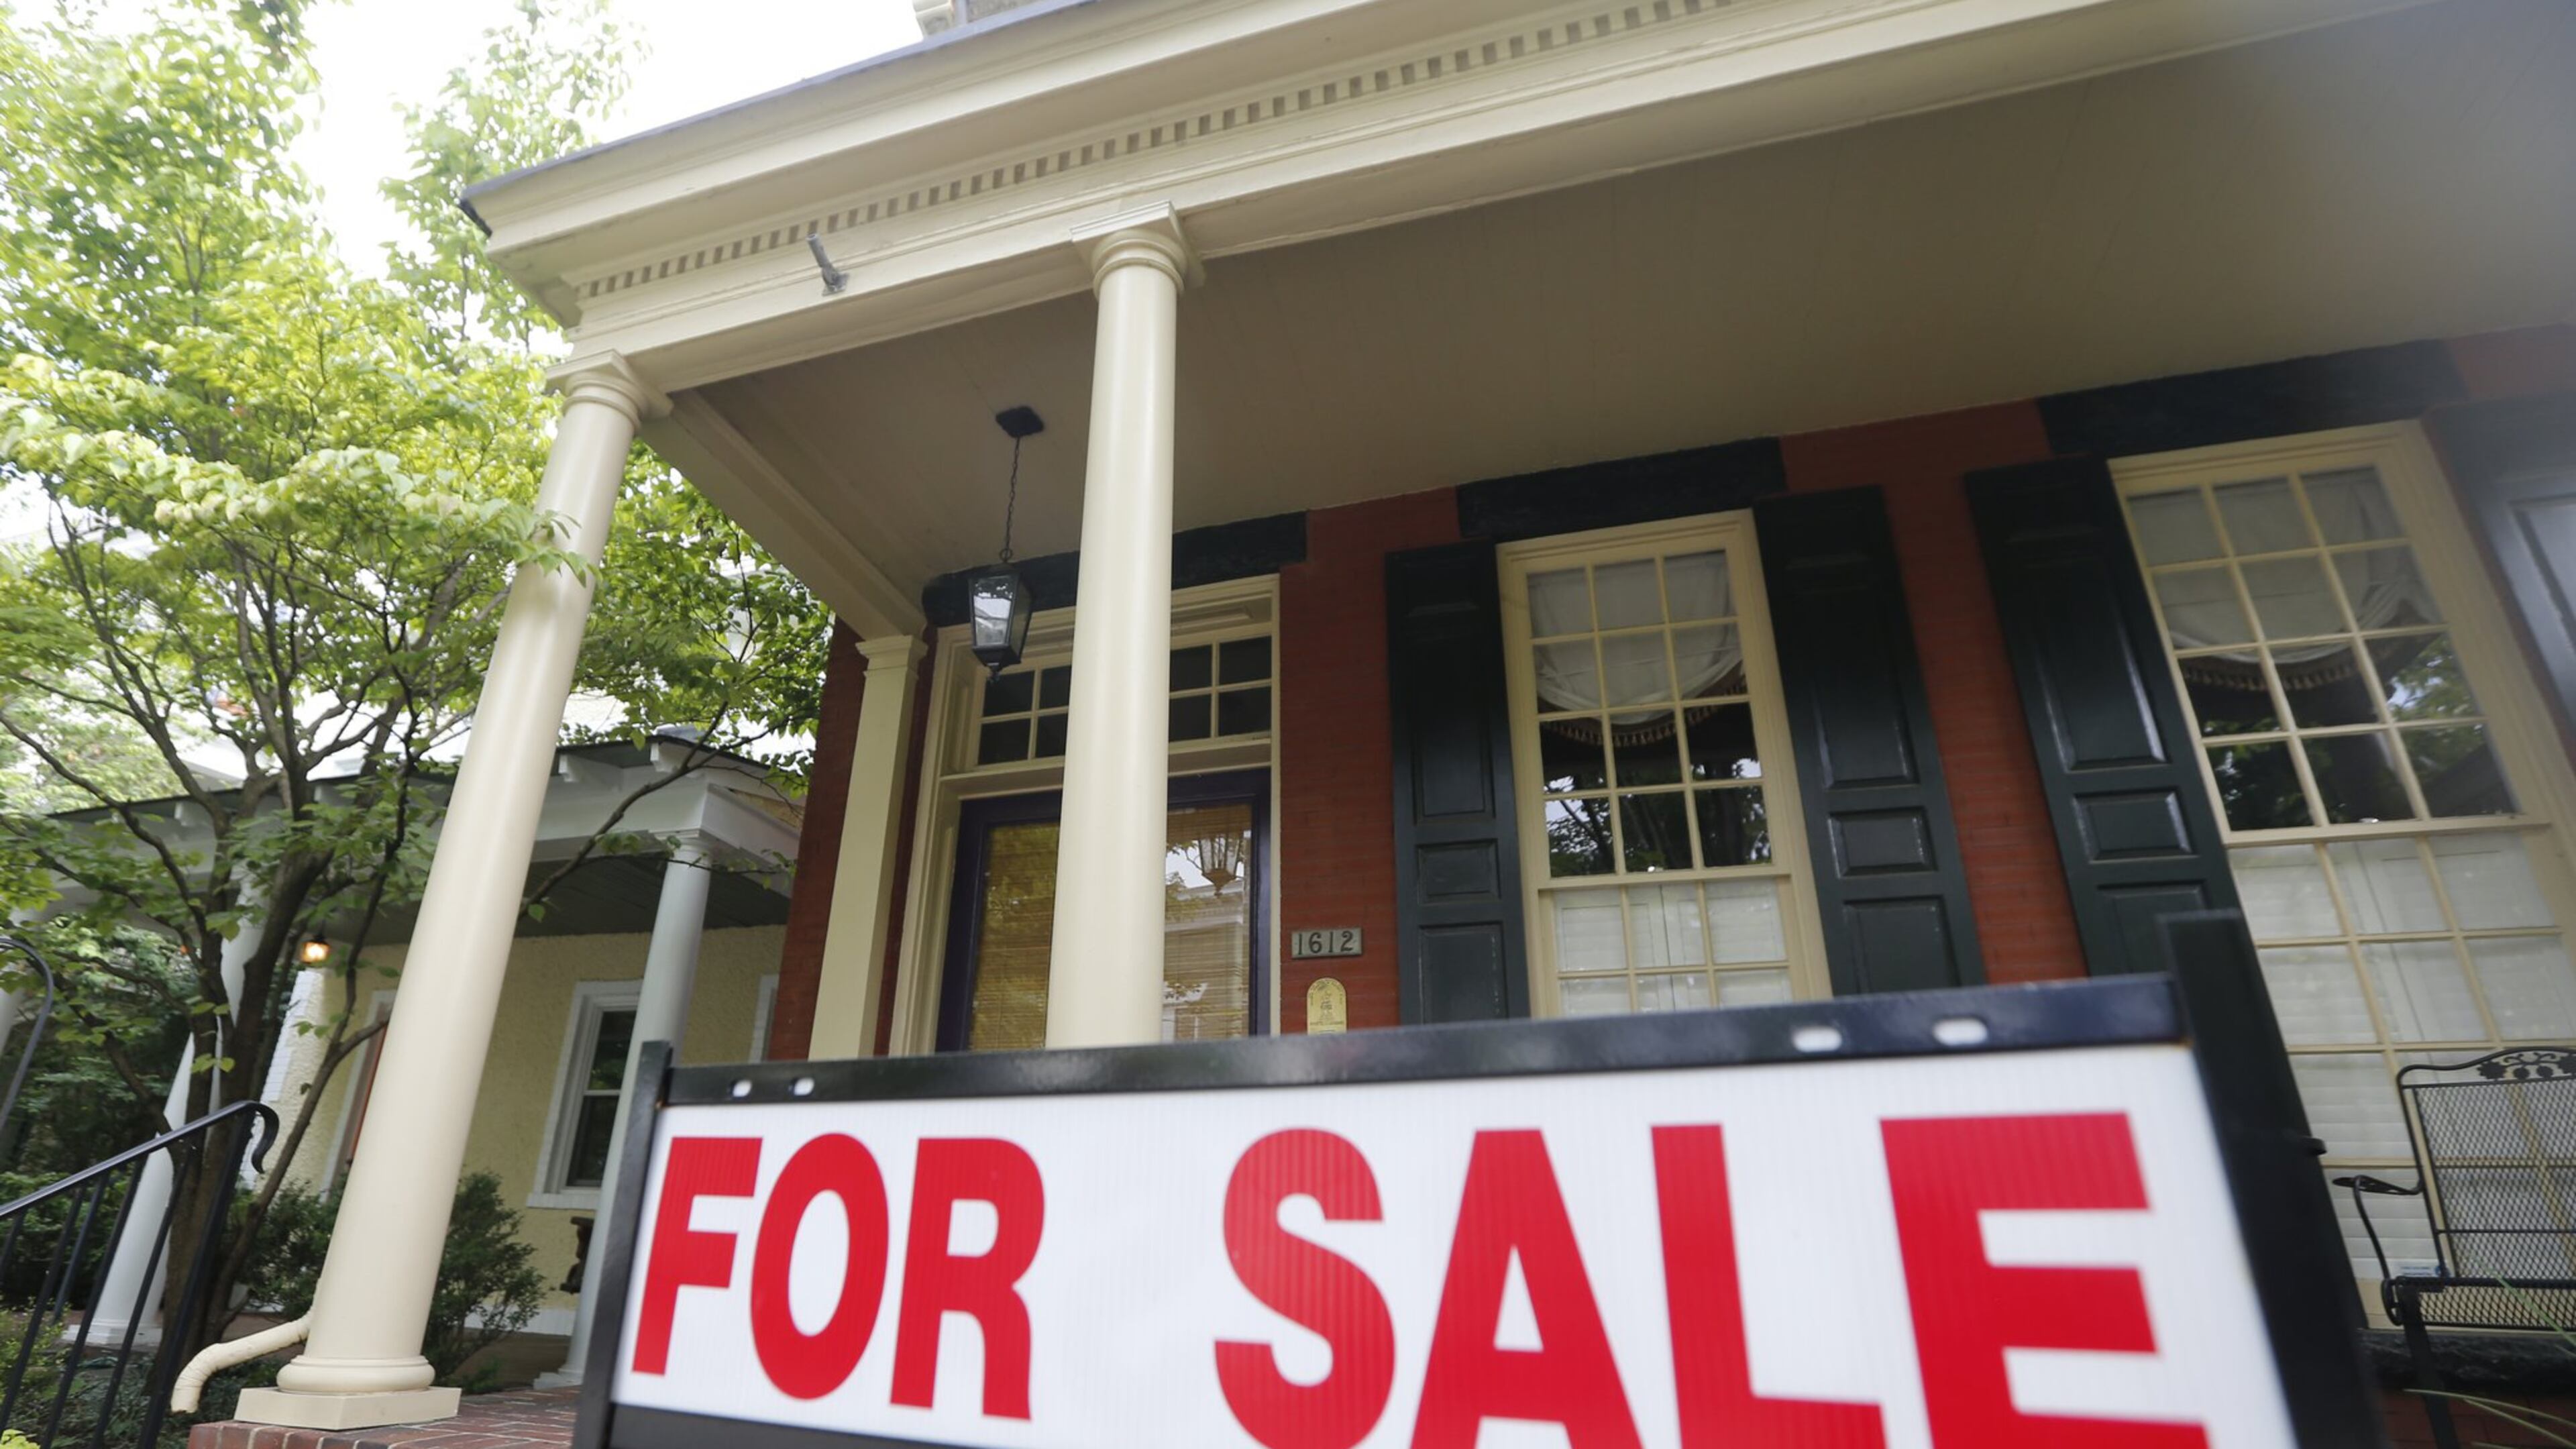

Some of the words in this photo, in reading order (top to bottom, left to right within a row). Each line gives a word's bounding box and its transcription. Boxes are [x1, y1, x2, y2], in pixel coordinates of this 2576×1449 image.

[1298, 930, 1353, 955] 1612
[632, 1132, 1046, 1421] FOR
[1214, 1112, 2212, 1449] SALE
